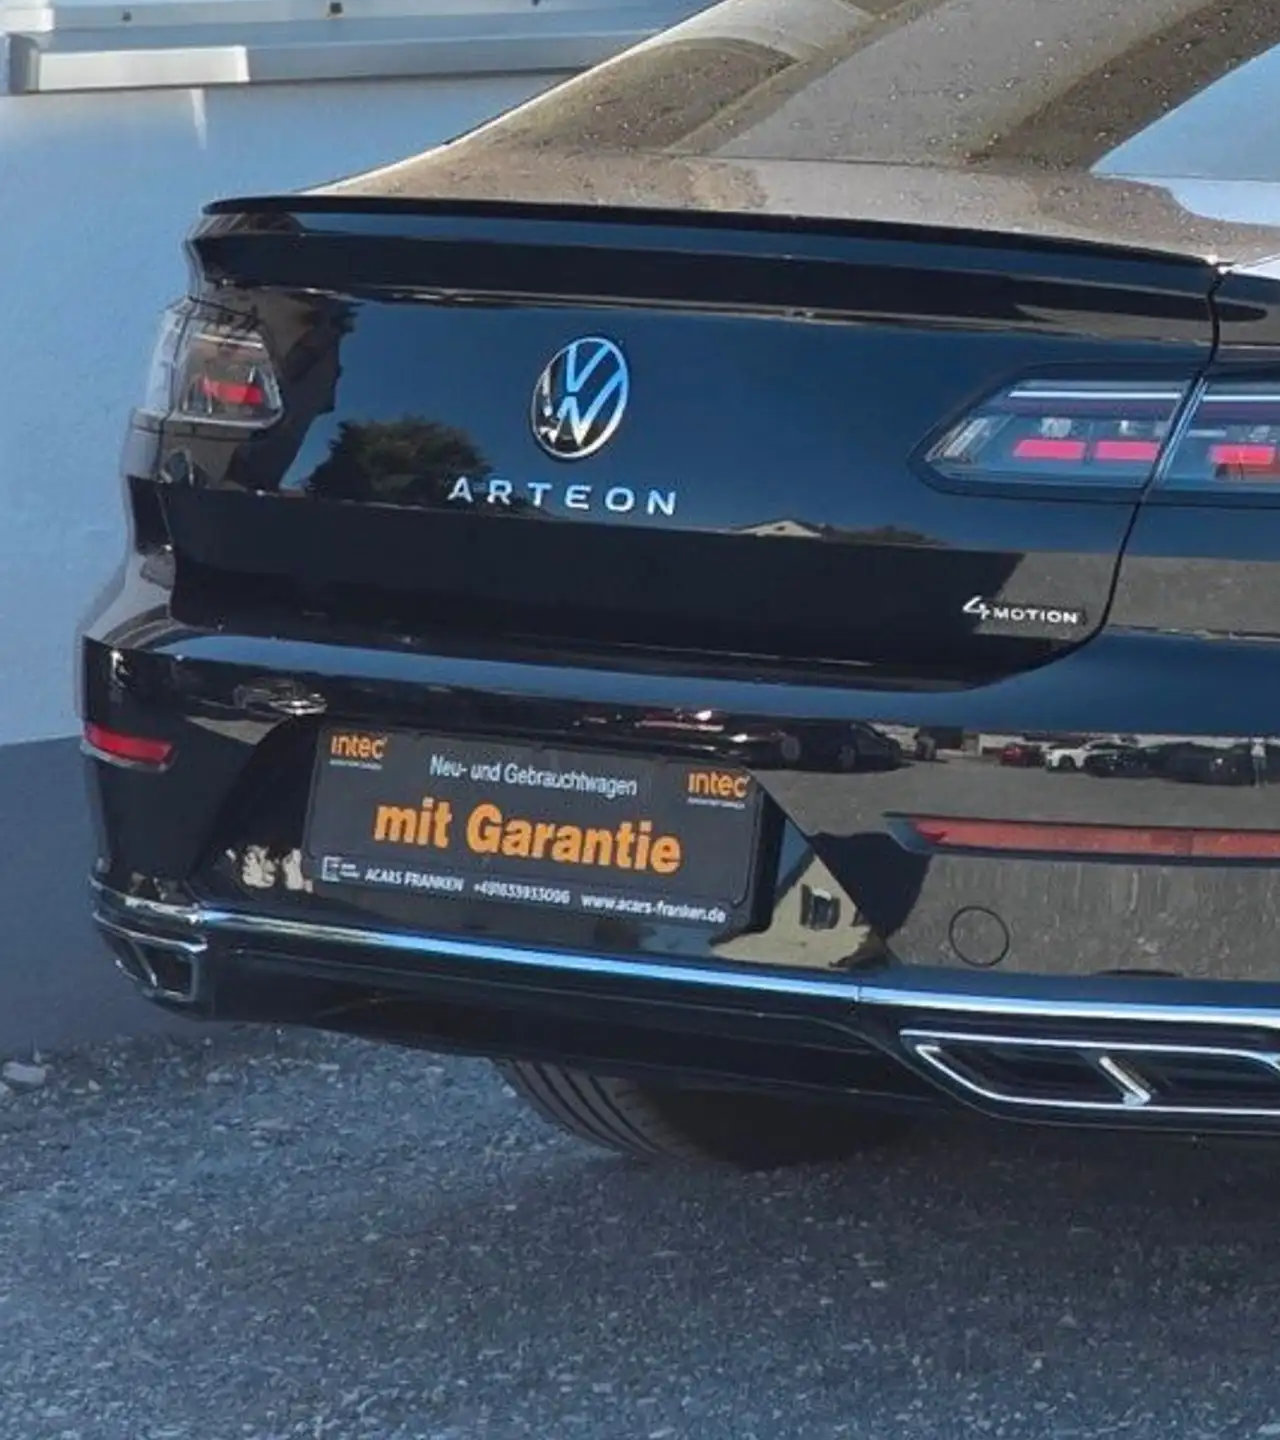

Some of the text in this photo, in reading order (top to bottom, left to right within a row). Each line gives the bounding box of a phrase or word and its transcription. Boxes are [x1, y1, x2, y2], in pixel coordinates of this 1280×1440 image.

[448, 476, 677, 516] ARTEON
[962, 595, 1078, 625] 4MOTION
[331, 734, 388, 760] intec
[430, 754, 638, 799] Neu- und Gebrauchtwagen
[687, 771, 749, 799] intec
[374, 796, 682, 874] mit Garantie
